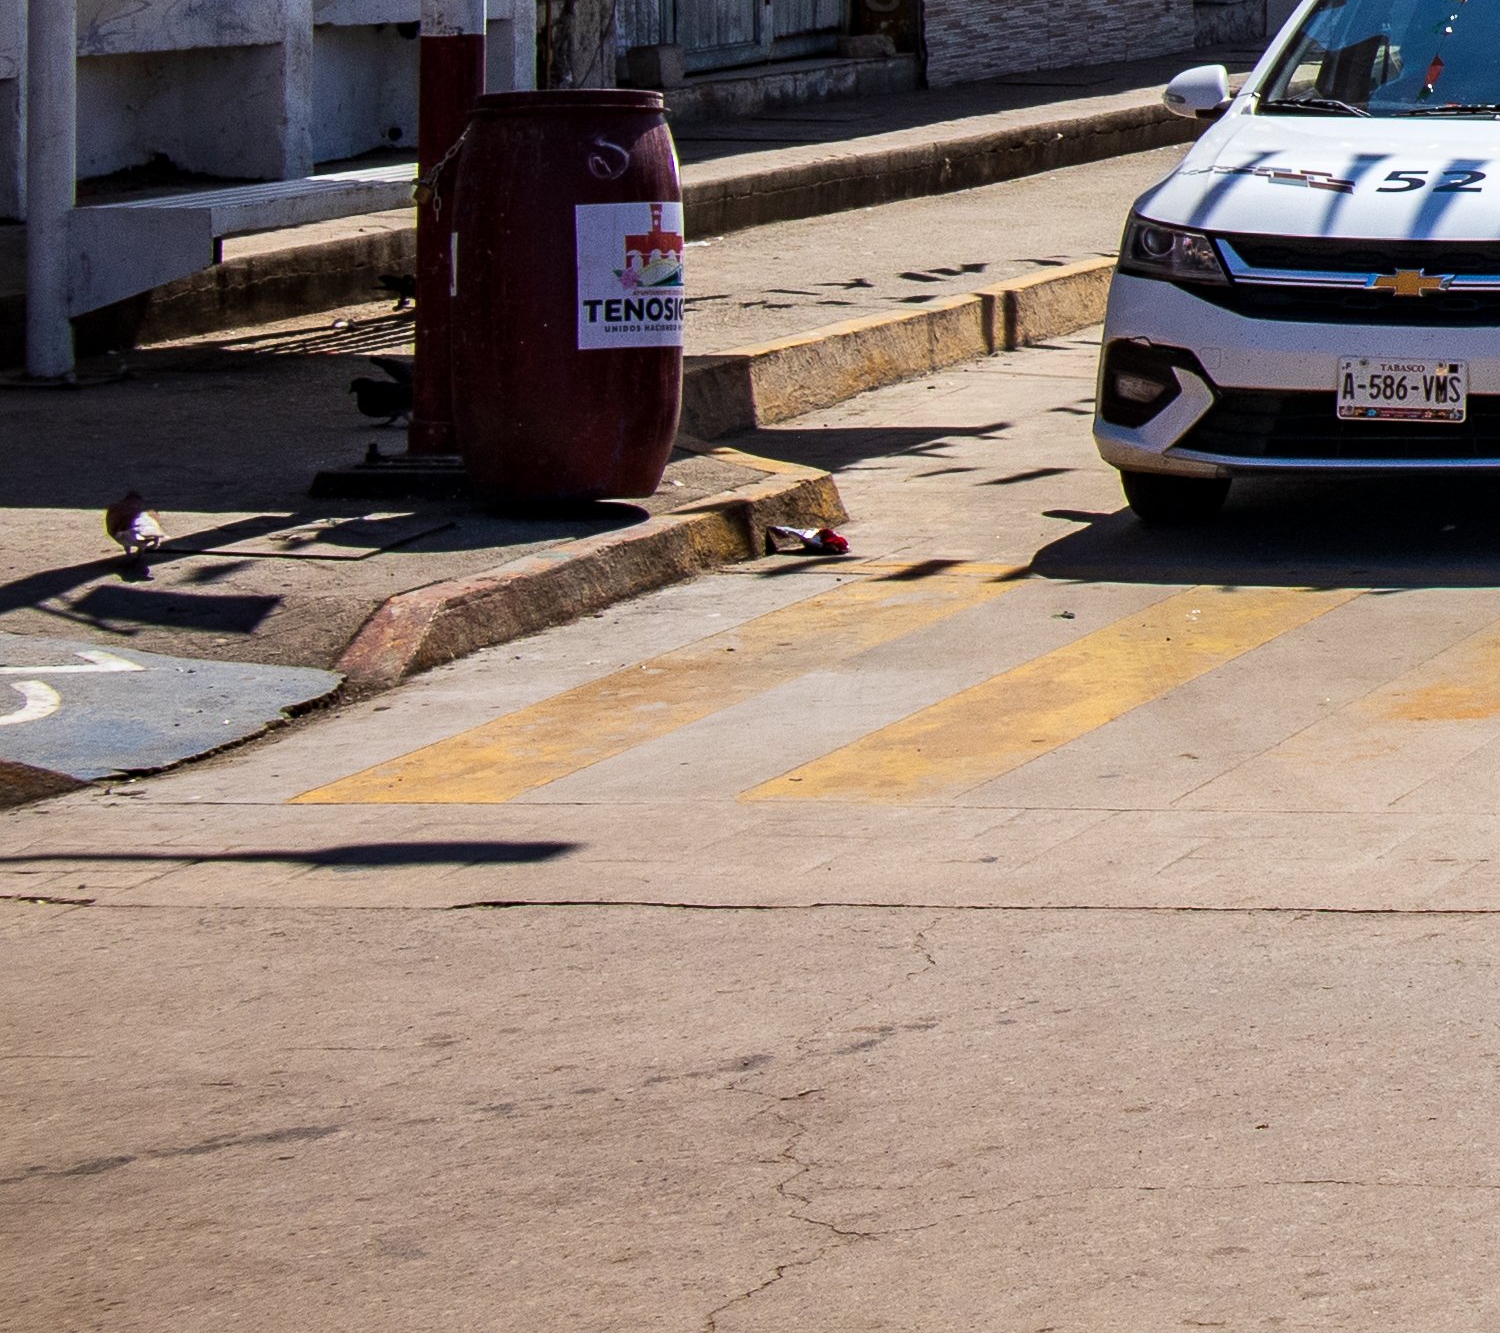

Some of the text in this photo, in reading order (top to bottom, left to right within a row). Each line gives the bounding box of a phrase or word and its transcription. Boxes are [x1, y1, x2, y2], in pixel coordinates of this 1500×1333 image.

[1376, 170, 1487, 193] 52
[605, 325, 641, 333] UNIDOS
[1380, 364, 1425, 372] TABASCO
[1342, 373, 1461, 403] A-586-VMS
